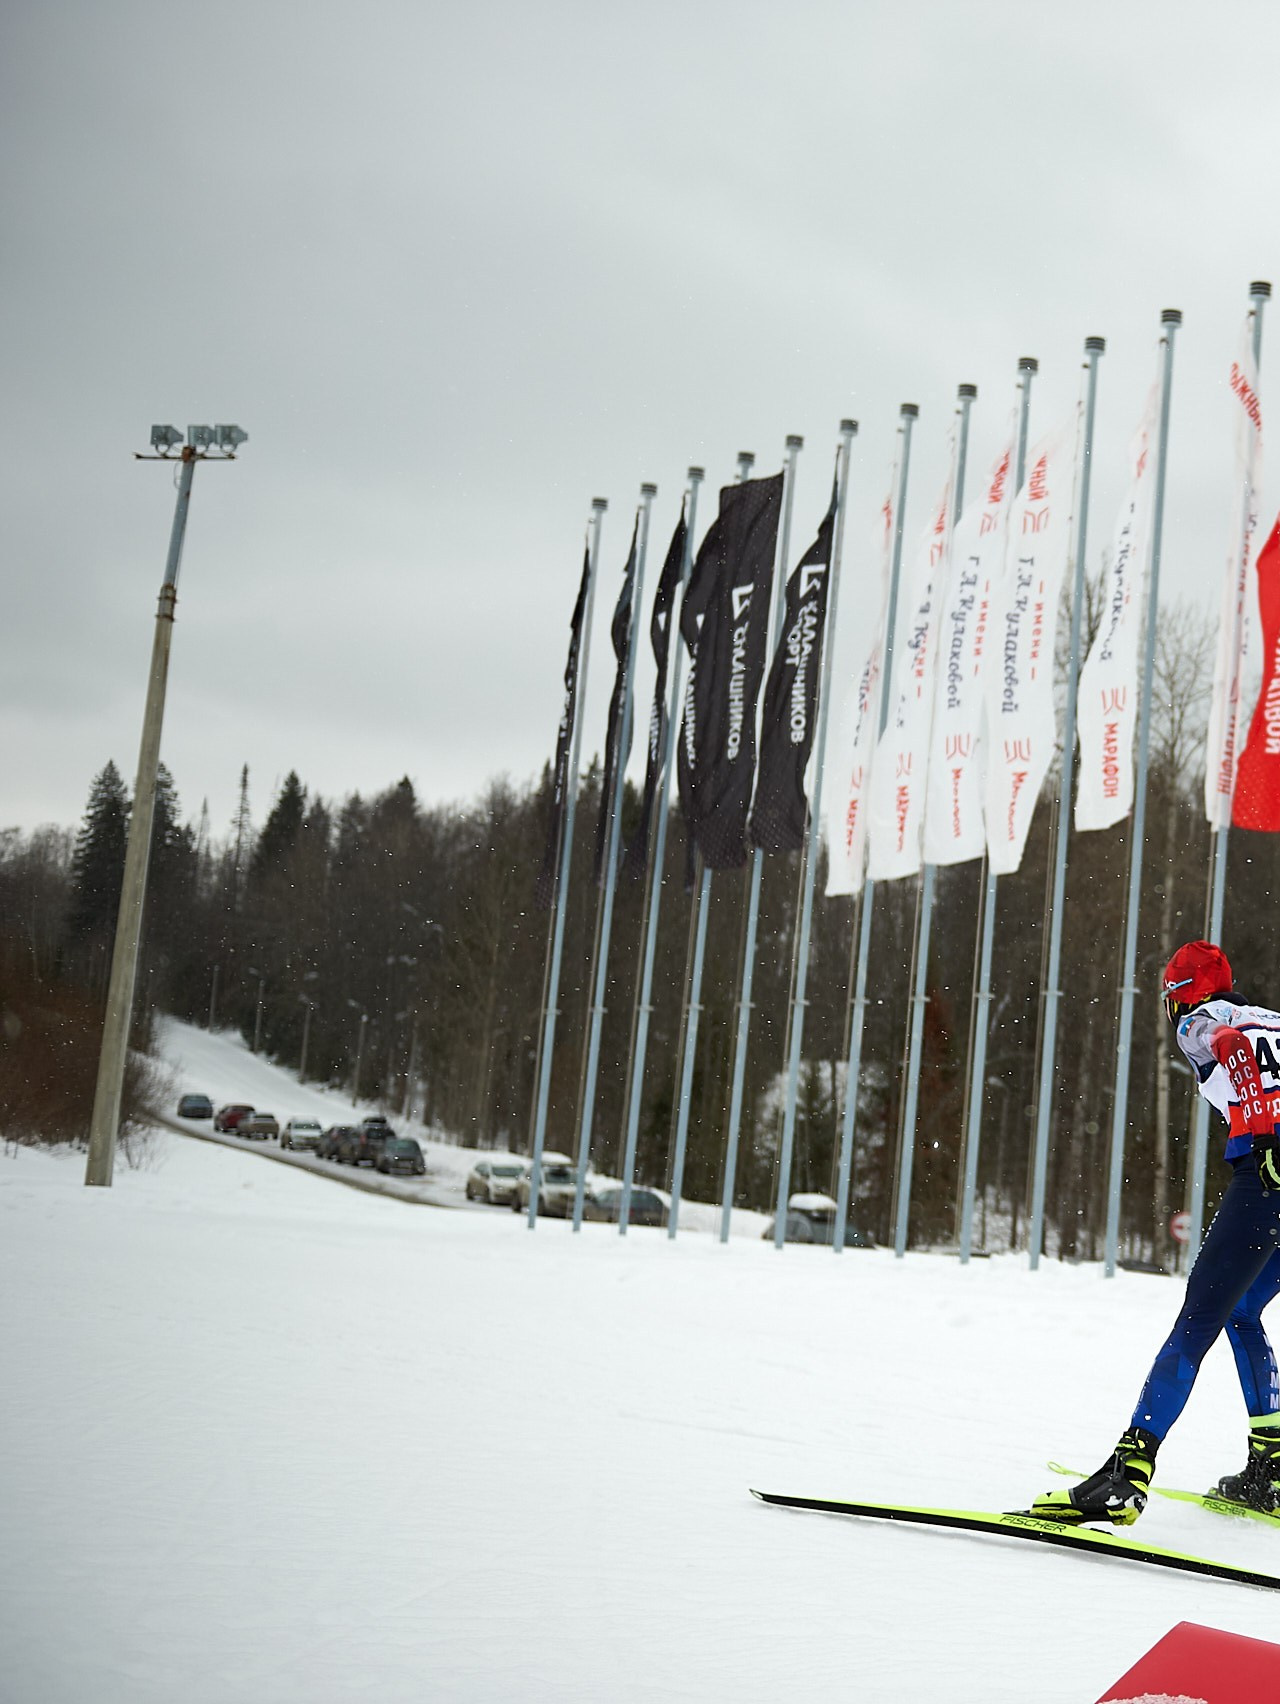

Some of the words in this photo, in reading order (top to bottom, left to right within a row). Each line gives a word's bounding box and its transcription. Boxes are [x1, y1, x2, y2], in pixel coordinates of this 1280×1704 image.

[974, 600, 989, 657] имени
[1030, 602, 1044, 659] имени
[1102, 722, 1118, 799] МАРАФОН
[999, 1515, 1067, 1533] FISCHER
